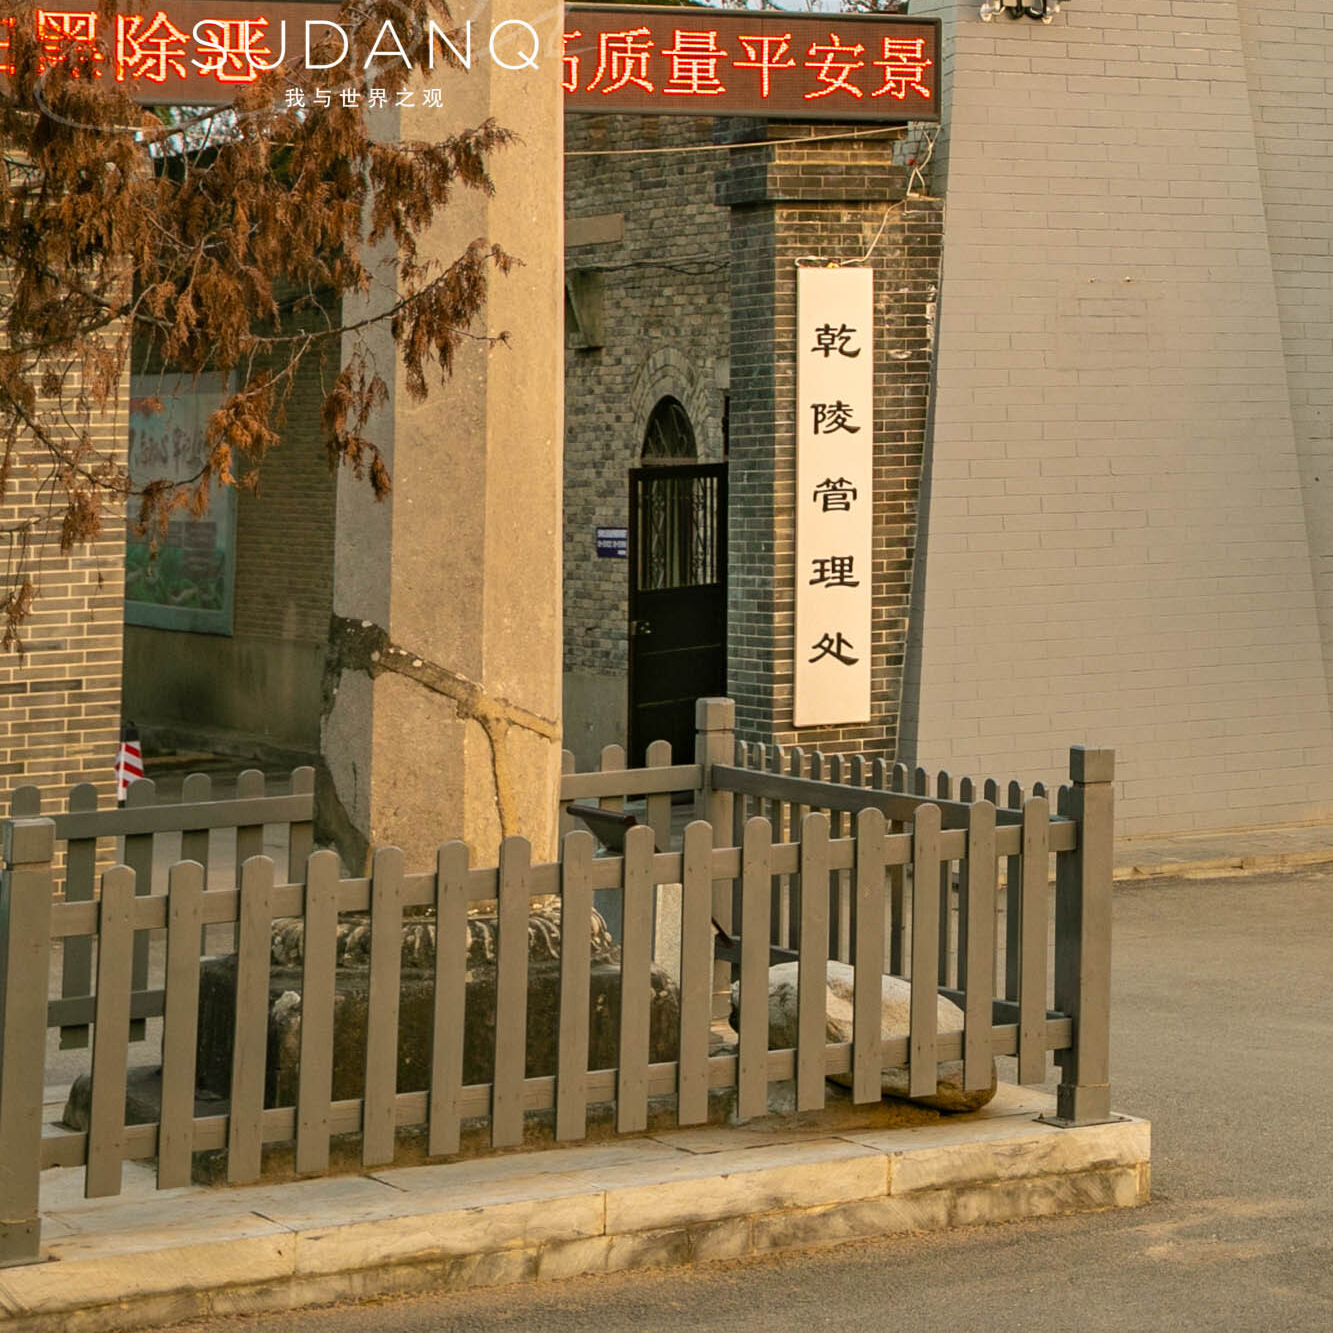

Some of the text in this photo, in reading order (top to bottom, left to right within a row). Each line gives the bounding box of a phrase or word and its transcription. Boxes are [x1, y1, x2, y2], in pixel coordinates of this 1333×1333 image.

[0, 10, 273, 83] 黑除恶
[807, 323, 862, 666] 乾陵管理处
